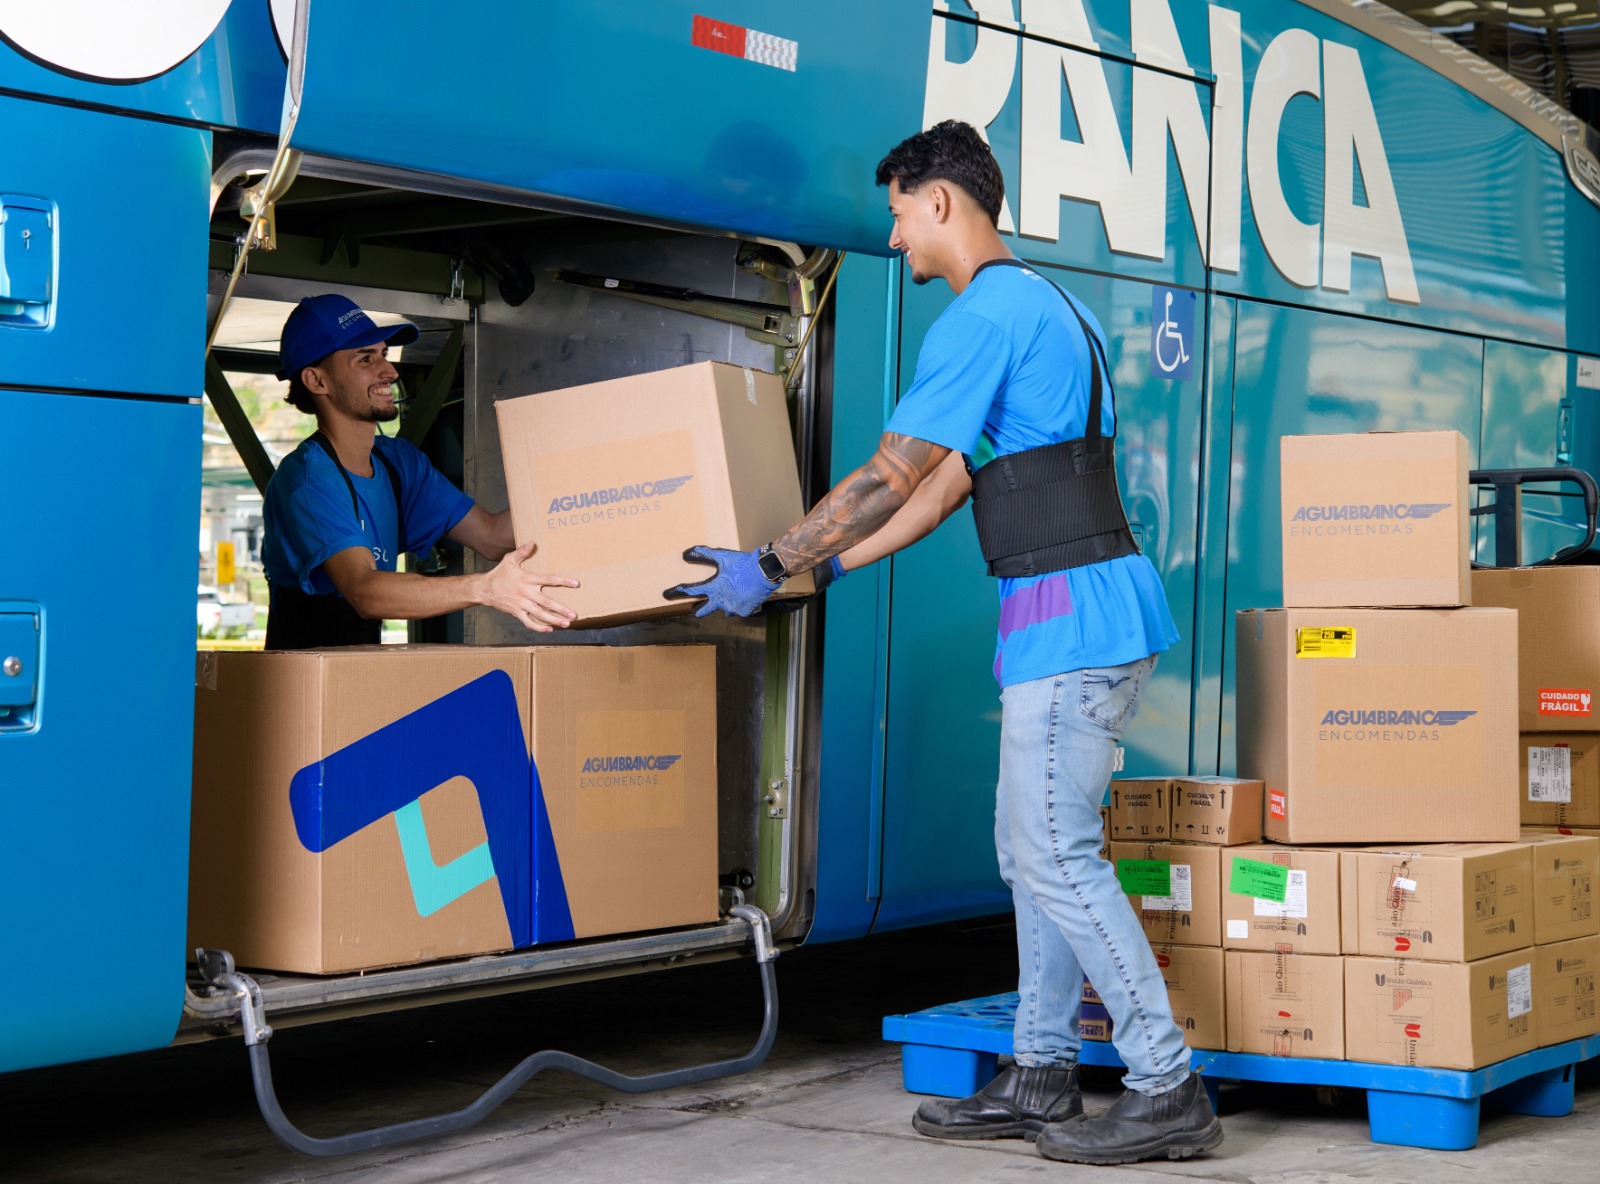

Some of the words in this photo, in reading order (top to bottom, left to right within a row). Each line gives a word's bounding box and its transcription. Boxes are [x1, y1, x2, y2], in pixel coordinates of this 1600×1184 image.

[547, 500, 662, 530] ENCOMENDAS
[1290, 523, 1414, 537] ENCOMENDAS
[1541, 692, 1580, 701] CUIDADO
[1541, 701, 1580, 712] FRÁGIL
[1319, 730, 1440, 741] ENCOMENDAS
[580, 774, 659, 789] ENCOMENDAS
